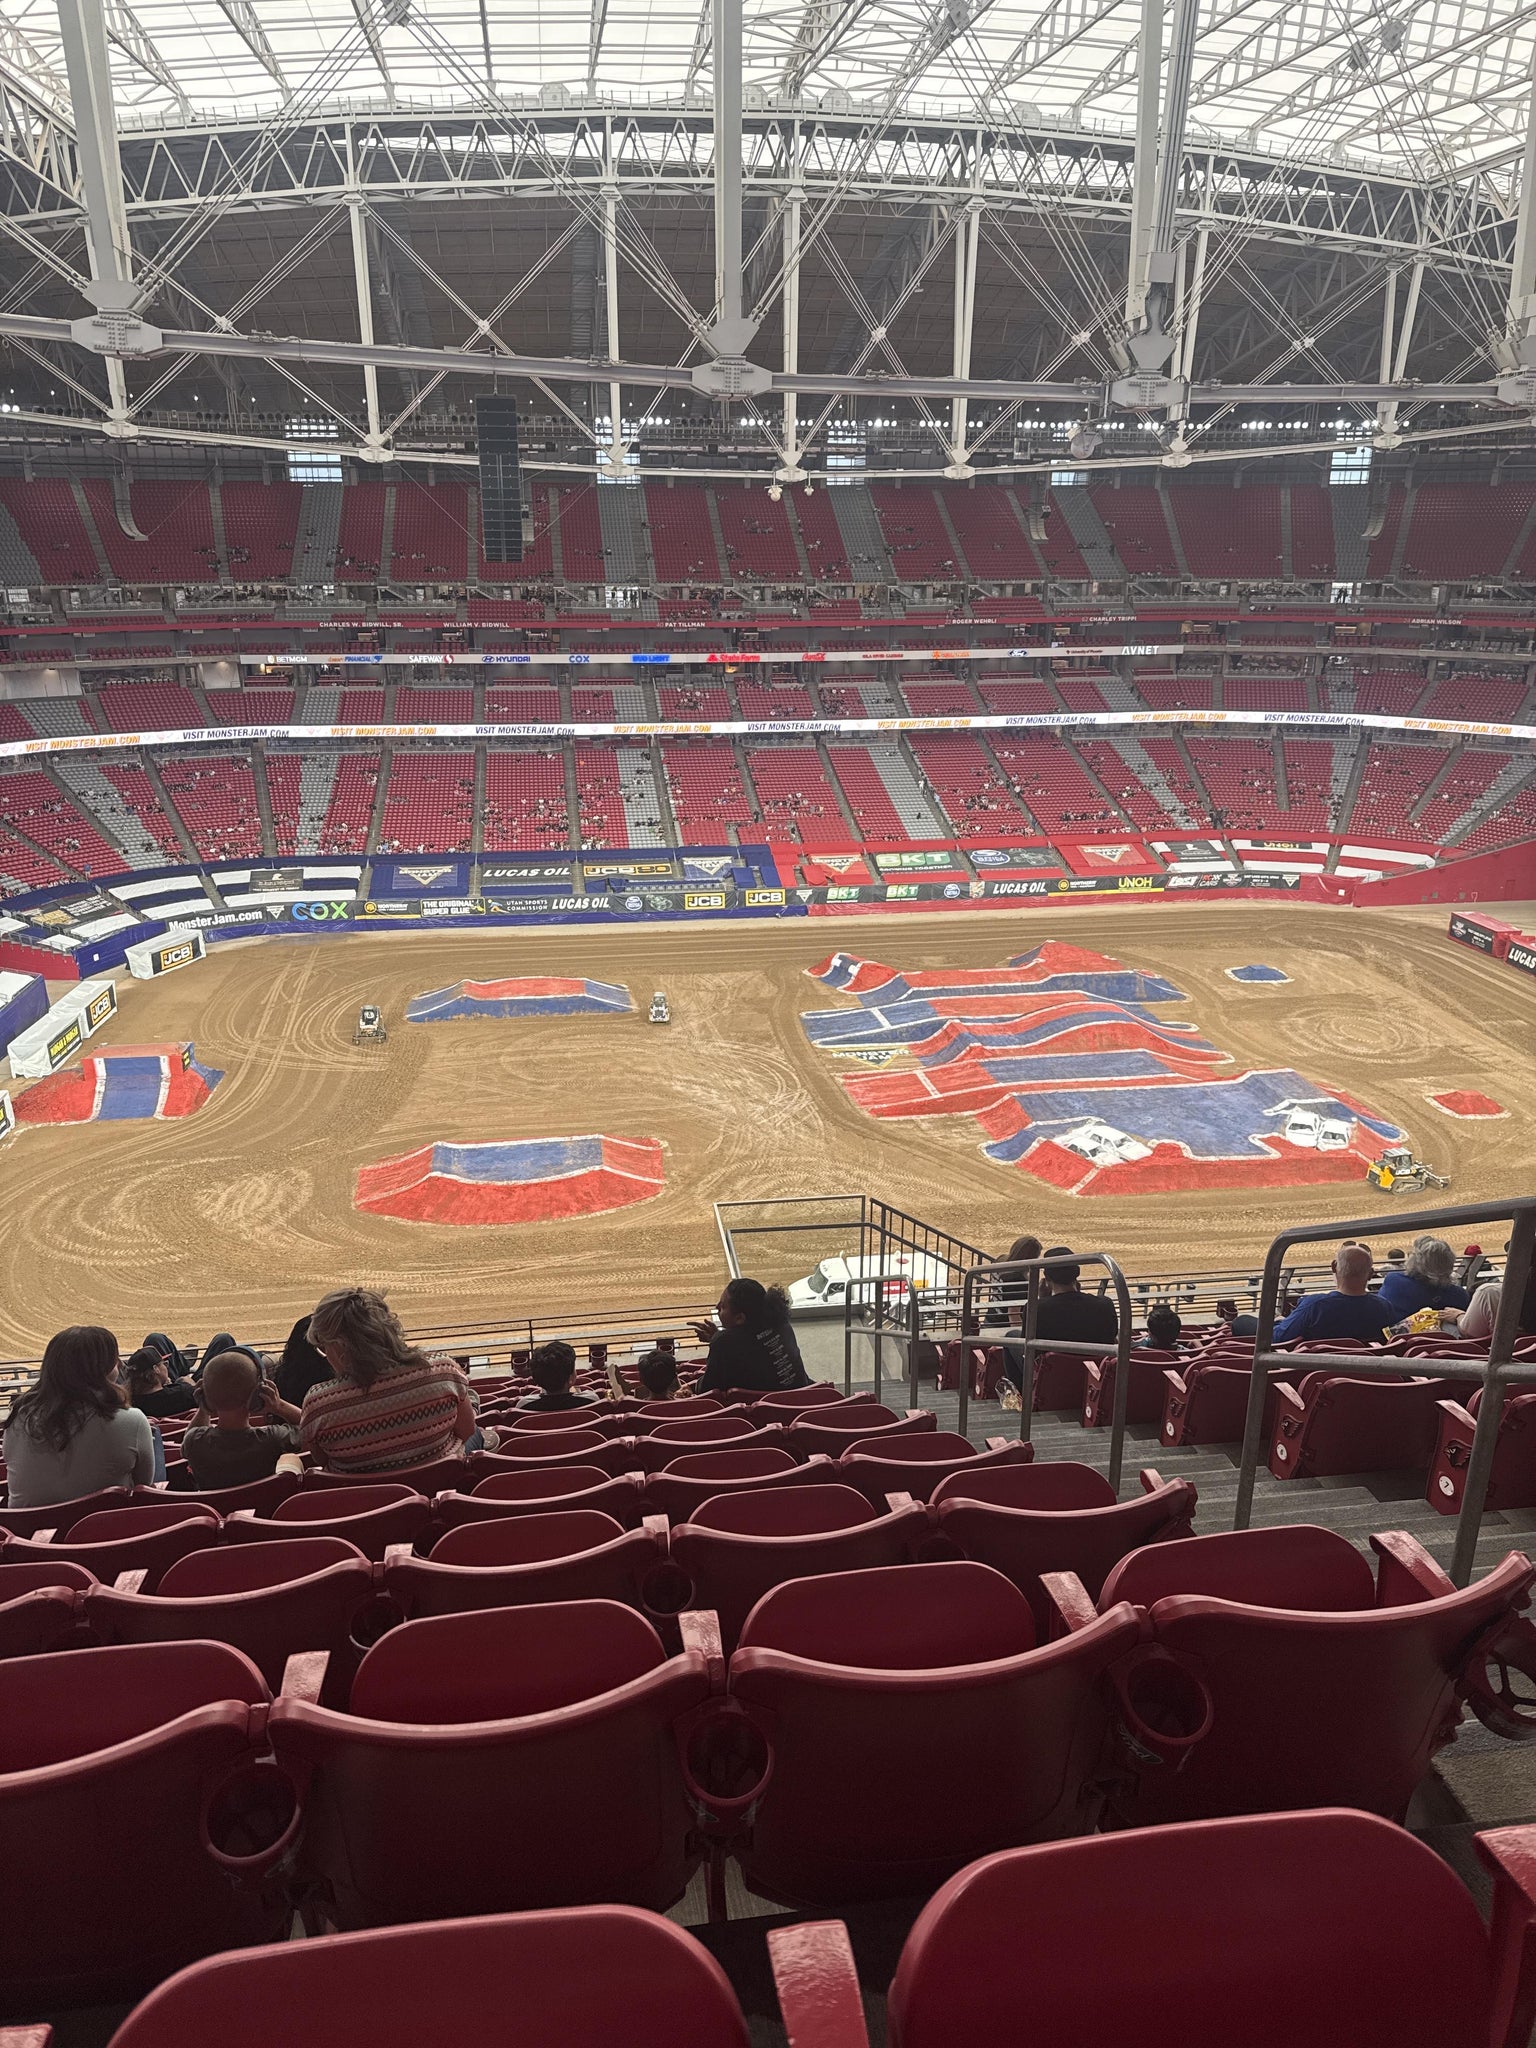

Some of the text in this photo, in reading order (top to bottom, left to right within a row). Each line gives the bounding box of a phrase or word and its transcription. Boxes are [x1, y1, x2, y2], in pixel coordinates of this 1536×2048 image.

[1122, 646, 1159, 655] AVNET
[408, 655, 444, 663] SAFEWAY
[878, 719, 971, 728] VISIT MONSTERJAM.COM
[1006, 716, 1096, 725] VISIT MONSTERJAM.COM
[1132, 713, 1226, 722] VISIT MONSTERJAM.COM
[1264, 714, 1364, 726] VISIT MONSTERJAM.COM
[330, 727, 436, 736] VISIT MONSTERJAM.COM
[476, 726, 575, 736] VISIT MONSTERJAM.COM
[614, 725, 712, 734] VISIT MONSTERJAM.COM
[768, 722, 842, 732] MONSTERJAM.COM
[1403, 720, 1512, 735] VISIT MONSTERJAM.COM
[182, 728, 290, 740] VISIT MONSTERJAM.COM
[25, 736, 140, 752] VISIT MONSTERJAM.COM
[877, 852, 950, 867] BKT
[483, 868, 573, 877] LUCAS OIL
[586, 866, 636, 874] JCB
[992, 882, 1047, 894] LUCAS OIL
[1118, 876, 1152, 888] UNOH
[749, 892, 783, 903] JCB
[827, 887, 860, 900] BKT
[886, 885, 918, 898] BKT
[438, 900, 473, 908] ORIGINAL
[552, 897, 611, 910] LUCAS OIL
[688, 896, 722, 907] JCB
[292, 902, 349, 920] COX
[168, 910, 262, 932] MonsterJam.com
[164, 947, 192, 966] JCB
[1508, 948, 1536, 968] LUCAS
[93, 996, 109, 1019] JCB
